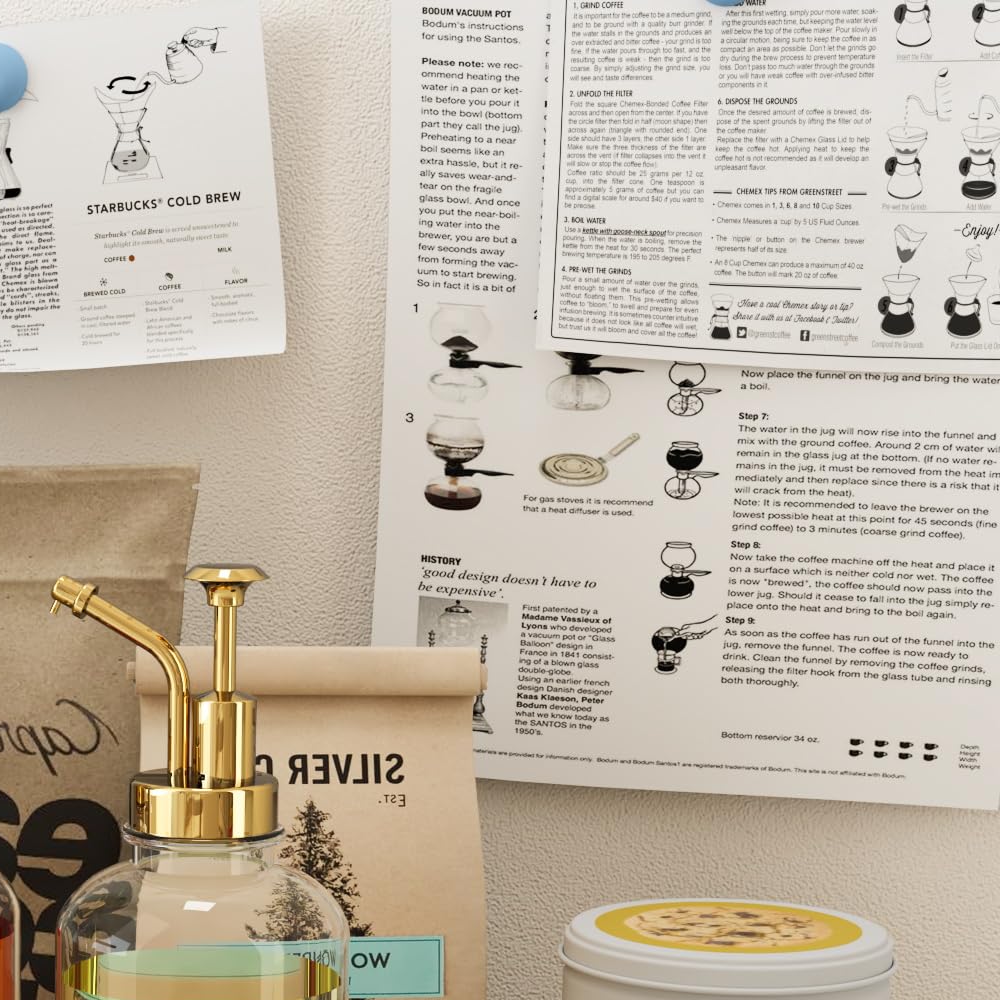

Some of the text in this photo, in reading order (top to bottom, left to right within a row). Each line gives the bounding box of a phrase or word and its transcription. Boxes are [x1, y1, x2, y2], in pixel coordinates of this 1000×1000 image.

[580, 1, 601, 10] GRIND
[601, 0, 624, 10] COFFEE
[422, 6, 512, 19] BODUM VACUUM POT
[422, 19, 525, 32] Bodum's instructions
[422, 32, 521, 45] for using the Santos.
[421, 57, 456, 67] Please
[458, 60, 485, 69] note:
[569, 90, 576, 98] 2.
[576, 90, 602, 98] UNFOLD
[615, 90, 633, 98] FILTER
[725, 97, 751, 106] DISPOSE
[753, 97, 764, 106] THE
[765, 97, 798, 106] GROUNDS
[736, 187, 843, 196] CHEMEX TIPS FROM GREENSTREET
[167, 195, 202, 208] COLD
[205, 191, 242, 205] BREW
[571, 216, 585, 224] BOIL
[586, 217, 607, 225] WATER
[962, 222, 999, 240] Enjoy!
[103, 255, 127, 264] COFFEE
[568, 266, 595, 274] PRE-WET
[596, 267, 607, 275] THE
[608, 267, 632, 276] GRINDS
[158, 283, 182, 291] COFFEE
[83, 290, 109, 298] BREWED
[413, 303, 419, 313] 1
[749, 382, 770, 391] boil.
[405, 412, 415, 424] 3
[738, 412, 770, 422] Step 7:
[730, 540, 762, 551] Step 8:
[421, 554, 462, 567] HISTORY
[458, 570, 498, 584] design
[502, 573, 548, 586] doesn't
[550, 576, 581, 588] have
[584, 580, 597, 588] to
[417, 581, 434, 592] be
[522, 604, 541, 613] First
[542, 606, 579, 614] patented
[580, 608, 592, 617] by
[521, 613, 560, 622] Madame
[560, 615, 601, 624] Vassieux
[725, 616, 756, 626] Step 9:
[721, 731, 754, 740] Bottom
